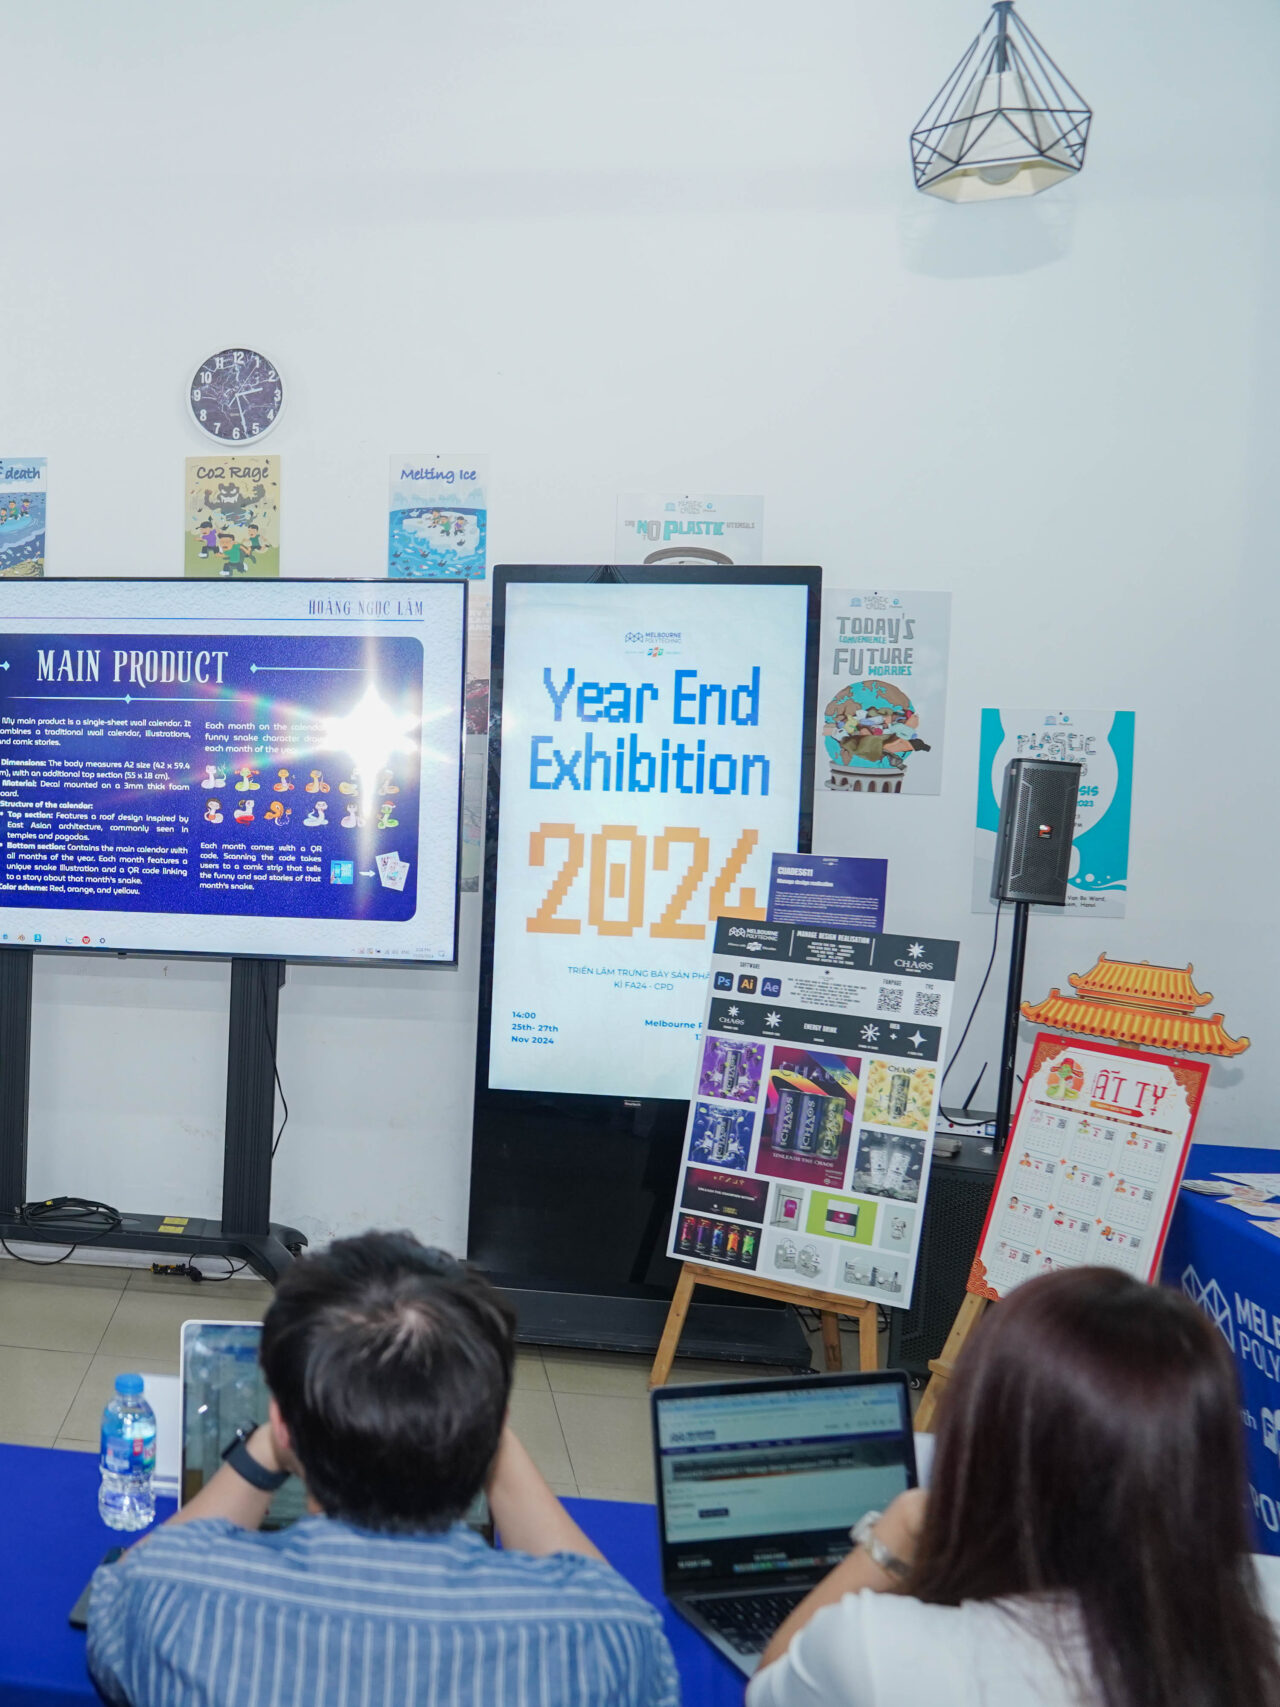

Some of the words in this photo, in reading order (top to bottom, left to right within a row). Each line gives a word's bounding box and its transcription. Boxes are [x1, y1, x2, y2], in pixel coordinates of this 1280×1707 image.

[214, 357, 224, 369] 11
[232, 351, 245, 364] 12
[254, 356, 260, 368] 1
[200, 371, 212, 384] 10
[268, 370, 276, 382] 2
[193, 389, 201, 402] 9
[273, 389, 281, 402] 3
[199, 409, 207, 422] 8
[267, 409, 274, 420] 4
[213, 422, 221, 434] 7
[232, 427, 240, 440] 6
[251, 422, 260, 434] 5
[5, 467, 40, 480] death
[196, 466, 226, 480] Co2
[229, 466, 269, 483] Rage
[400, 467, 455, 484] Melting
[459, 469, 477, 481] Ice
[636, 520, 661, 541] NO
[663, 520, 725, 541] PLASTIC
[836, 612, 916, 644] TODAY'S
[832, 647, 914, 676] FUTURE
[37, 649, 101, 682] MAIN
[112, 650, 229, 688] PRODUCT
[867, 665, 912, 676] WORRIES
[542, 666, 659, 724] Year
[674, 666, 761, 726] End
[1, 717, 16, 726] My
[17, 717, 36, 725] main
[37, 717, 66, 726] product
[82, 718, 128, 727] single-sheet
[130, 719, 147, 727] wall
[148, 719, 183, 727] calendar.
[183, 719, 191, 727] It
[44, 728, 83, 736] traditional
[87, 729, 104, 737] wall
[107, 729, 142, 738] calendar,
[145, 730, 191, 739] illustrations,
[12, 738, 33, 746] comic
[34, 738, 61, 746] stories.
[0, 758, 47, 767] Dimensions:
[48, 759, 62, 767] The
[64, 760, 83, 769] body
[85, 761, 122, 769] measures
[123, 761, 134, 769] A2
[136, 761, 151, 769] size
[152, 761, 165, 770] (42
[174, 762, 190, 770] 59.4
[529, 731, 770, 797] Exhibition
[12, 769, 30, 777] with
[42, 770, 80, 778] additional
[81, 771, 95, 780] top
[96, 771, 123, 779] section
[124, 771, 136, 780] (55
[144, 772, 153, 780] 18
[525, 822, 767, 940] 2024
[745, 933, 778, 942] POLYTECHNIC
[746, 928, 779, 937] MELBOURNE
[796, 930, 818, 939] MANAGE
[818, 932, 837, 941] DESIGN
[837, 934, 870, 945] REALISATION
[739, 961, 761, 970] SOFTWARE
[893, 958, 934, 972] CHAOS
[624, 981, 647, 990] FA24
[654, 982, 674, 991] CPD
[717, 976, 731, 987] Ps
[741, 979, 754, 990] Ai
[763, 982, 779, 993] Ae
[512, 1011, 536, 1020] 14:00
[718, 1016, 745, 1026] CHAOS
[511, 1023, 535, 1032] 25th-
[538, 1024, 559, 1033] 27th
[644, 1019, 695, 1030] Melbourne
[511, 1035, 529, 1044] Nov
[531, 1036, 554, 1045] 2024
